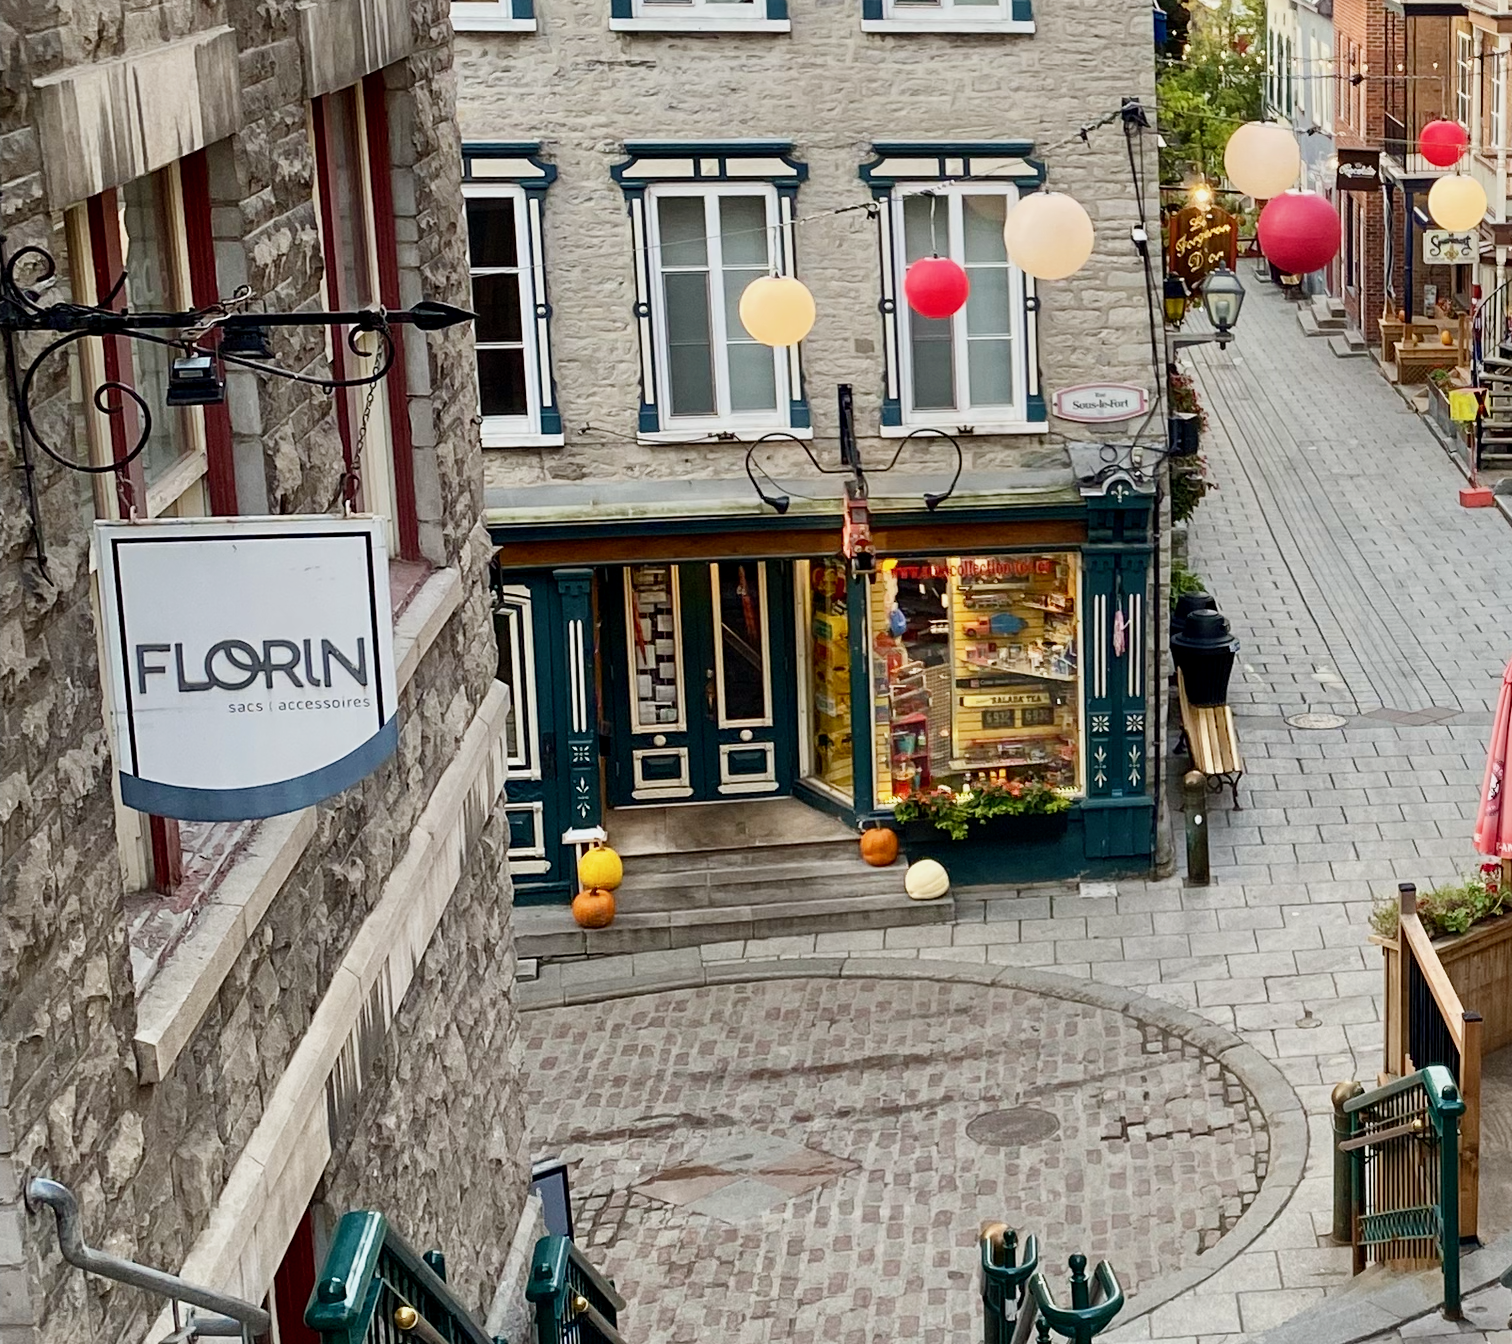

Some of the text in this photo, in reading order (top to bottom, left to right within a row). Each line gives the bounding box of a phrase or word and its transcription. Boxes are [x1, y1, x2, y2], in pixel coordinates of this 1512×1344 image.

[1072, 398, 1129, 410] Sous-le-Fort
[135, 637, 368, 694] FLORIN
[228, 701, 264, 714] sacs
[278, 697, 371, 712] accessoires
